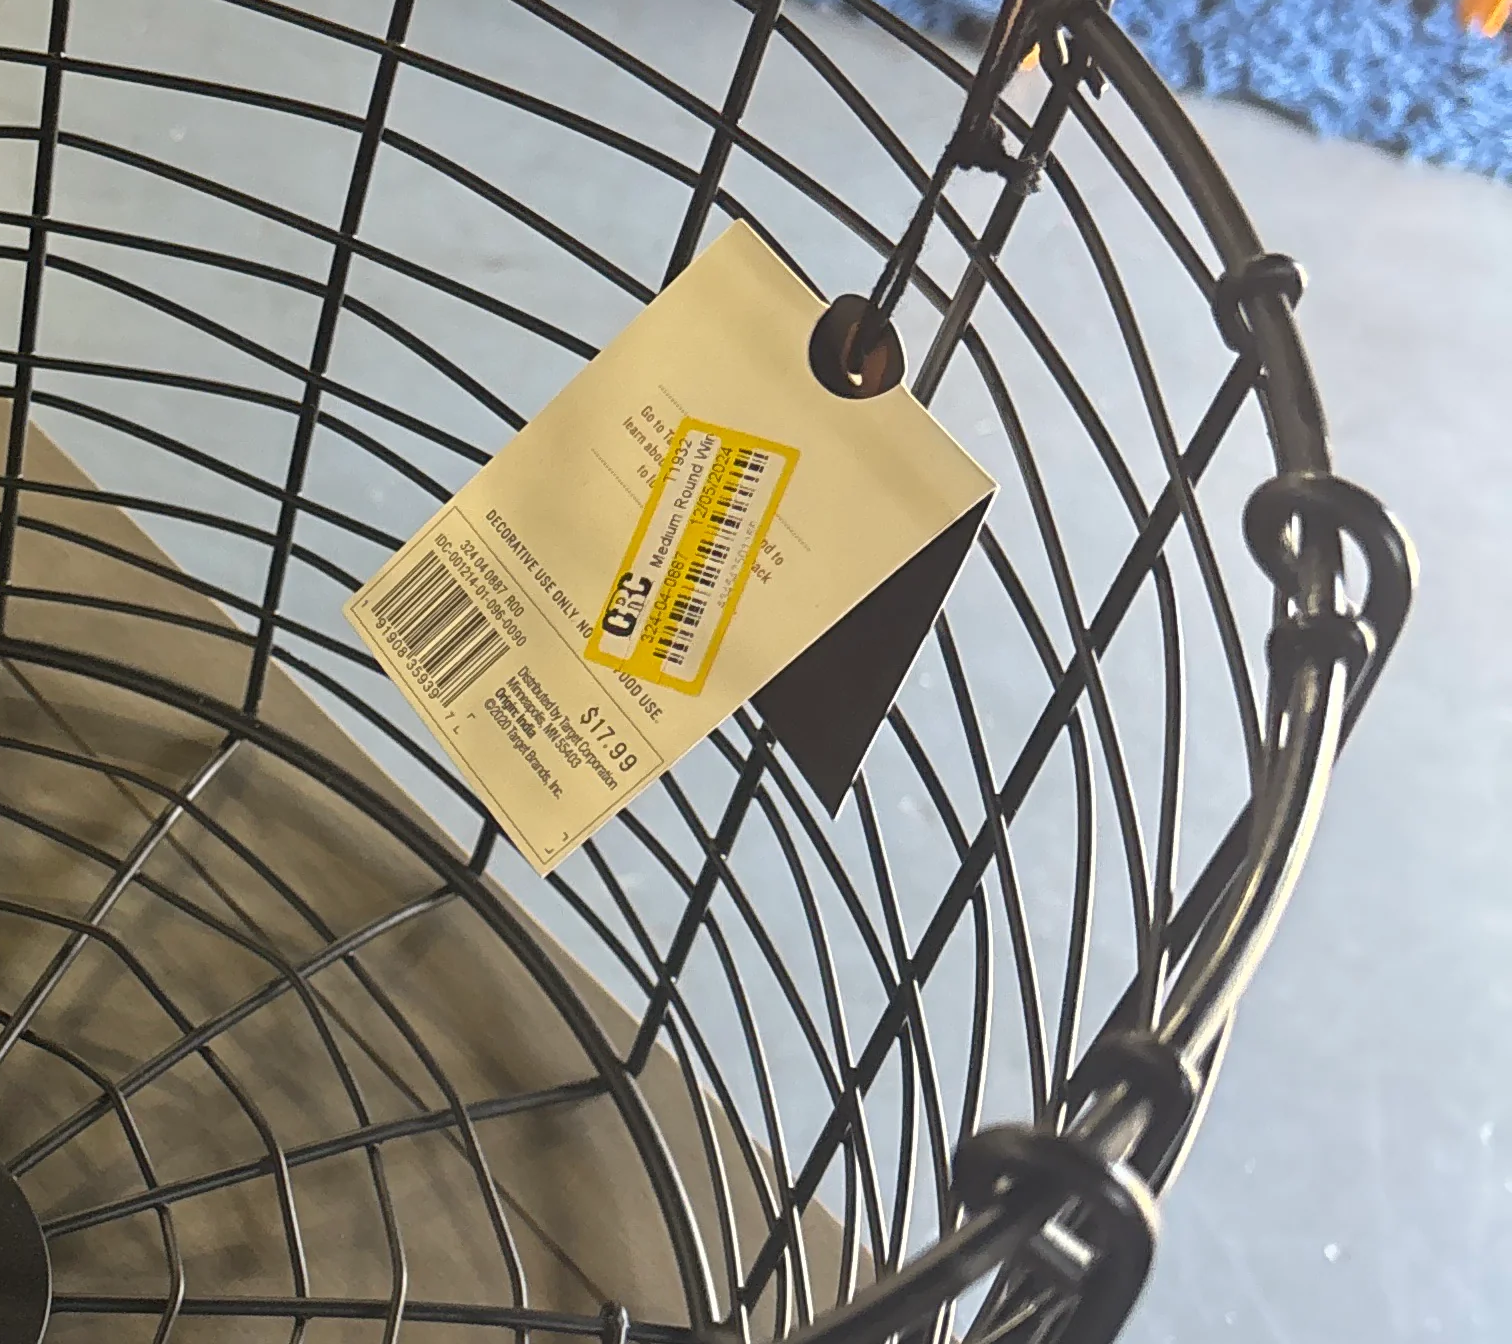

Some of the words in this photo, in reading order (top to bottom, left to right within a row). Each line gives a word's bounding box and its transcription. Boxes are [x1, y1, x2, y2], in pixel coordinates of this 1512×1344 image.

[622, 416, 648, 444] learn
[748, 557, 773, 583] ack
[636, 465, 650, 478] to
[640, 405, 657, 422] Go
[652, 420, 665, 433] to
[758, 536, 776, 553] nd
[771, 551, 785, 565] to
[663, 436, 692, 485] T1932
[485, 509, 539, 571] DECORATIVE
[533, 568, 556, 592] USE
[641, 551, 688, 643] 324-04-0887
[689, 444, 733, 527] 12/05/2024
[650, 512, 681, 568] Medium
[674, 462, 703, 509] Round
[459, 539, 479, 560] 324
[473, 557, 489, 573] 04
[483, 569, 507, 595] 0887
[373, 618, 409, 657] 91908
[404, 658, 441, 700] 35939
[482, 697, 512, 730] ©2020
[504, 726, 531, 756] Target
[522, 751, 554, 785] Brands,
[547, 780, 566, 799] Inc.
[492, 687, 521, 718] Origin:
[515, 714, 538, 738] India
[503, 677, 549, 728] Minneapolis,
[542, 723, 560, 742] MN
[553, 738, 582, 768] 55403
[516, 666, 556, 710] Distributed
[547, 706, 563, 722] by
[555, 716, 583, 746] Target
[575, 741, 620, 791] Corporation
[577, 704, 640, 774] $17.99
